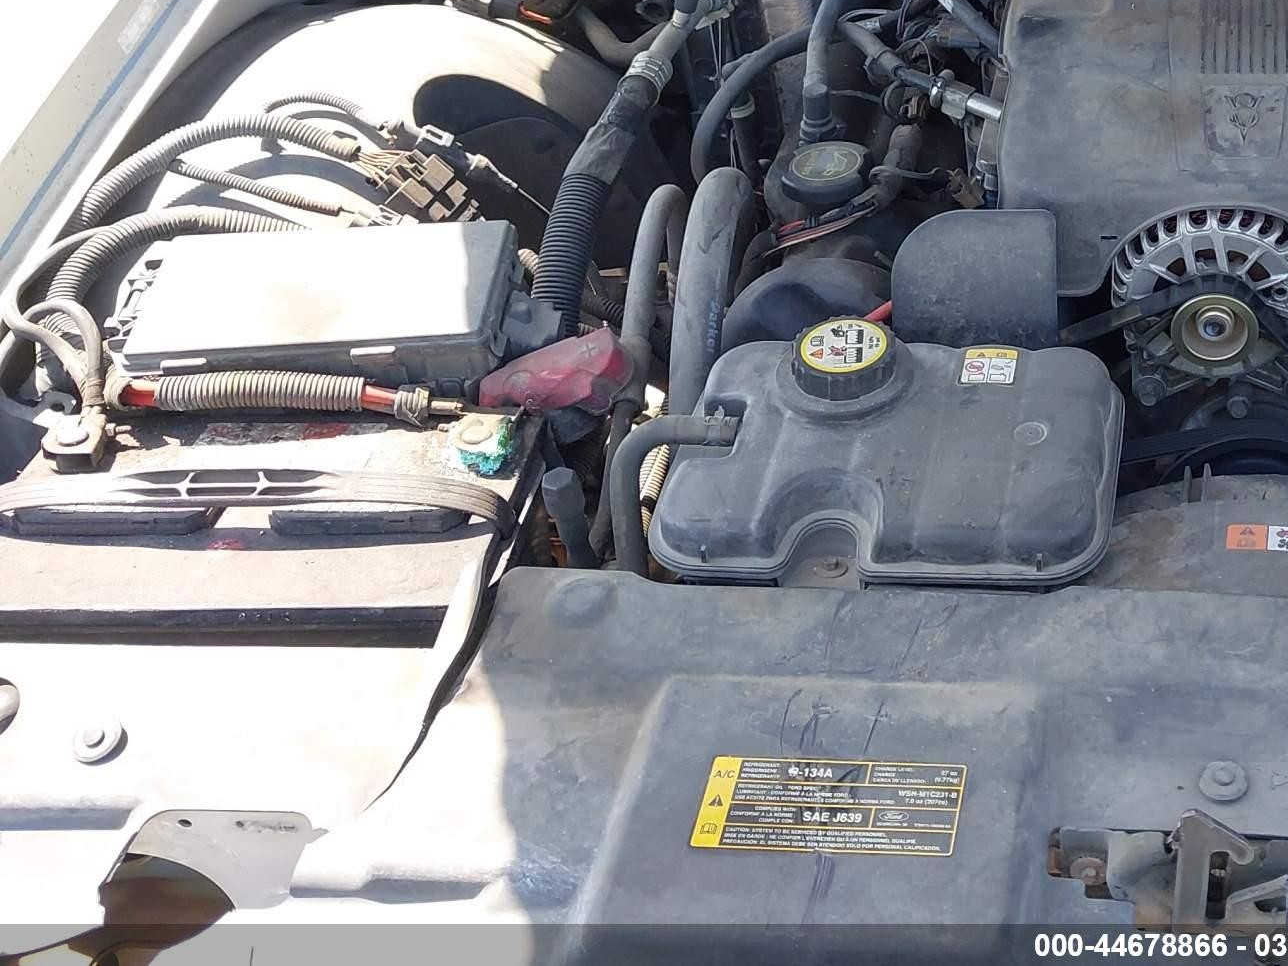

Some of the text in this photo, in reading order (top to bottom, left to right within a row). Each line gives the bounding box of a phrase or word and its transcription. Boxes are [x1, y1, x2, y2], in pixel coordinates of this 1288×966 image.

[713, 769, 736, 779] A/C
[802, 811, 862, 823] SAE J639
